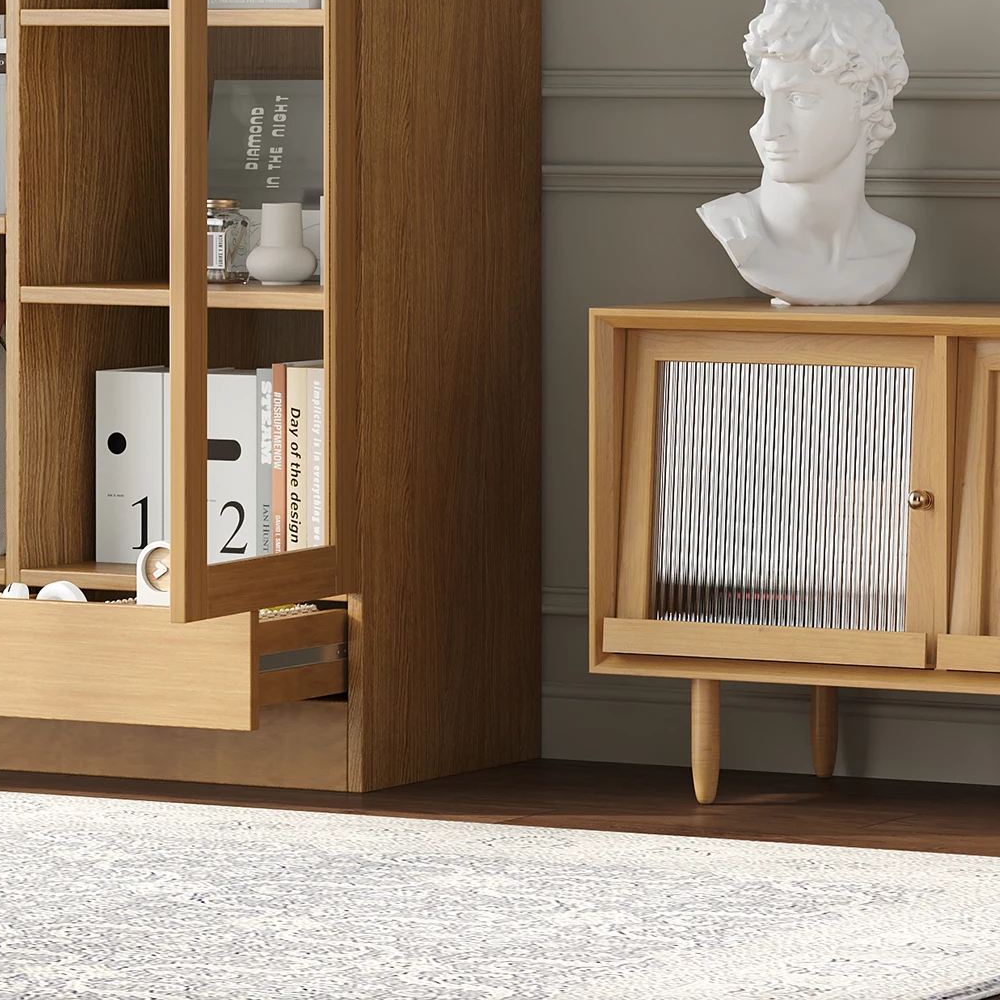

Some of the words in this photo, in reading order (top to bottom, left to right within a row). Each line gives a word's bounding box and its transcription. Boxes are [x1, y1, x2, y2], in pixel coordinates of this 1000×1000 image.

[272, 95, 289, 138] NIGHT
[245, 107, 265, 170] DIAMOND
[268, 147, 283, 170] THE
[266, 176, 280, 188] IN
[289, 407, 301, 437] Day
[312, 380, 320, 434] simplicity
[261, 380, 272, 465] STEAM
[273, 392, 282, 470] #DISRUPTMENOW
[290, 441, 301, 459] of
[314, 438, 321, 448] is
[314, 451, 321, 462] in
[290, 463, 301, 488] the
[312, 465, 321, 523] everything
[132, 496, 148, 550] 1
[220, 501, 248, 554] 2
[262, 504, 270, 522] IAN
[288, 491, 301, 544] design
[262, 524, 270, 552] HUNT
[313, 526, 320, 541] we
